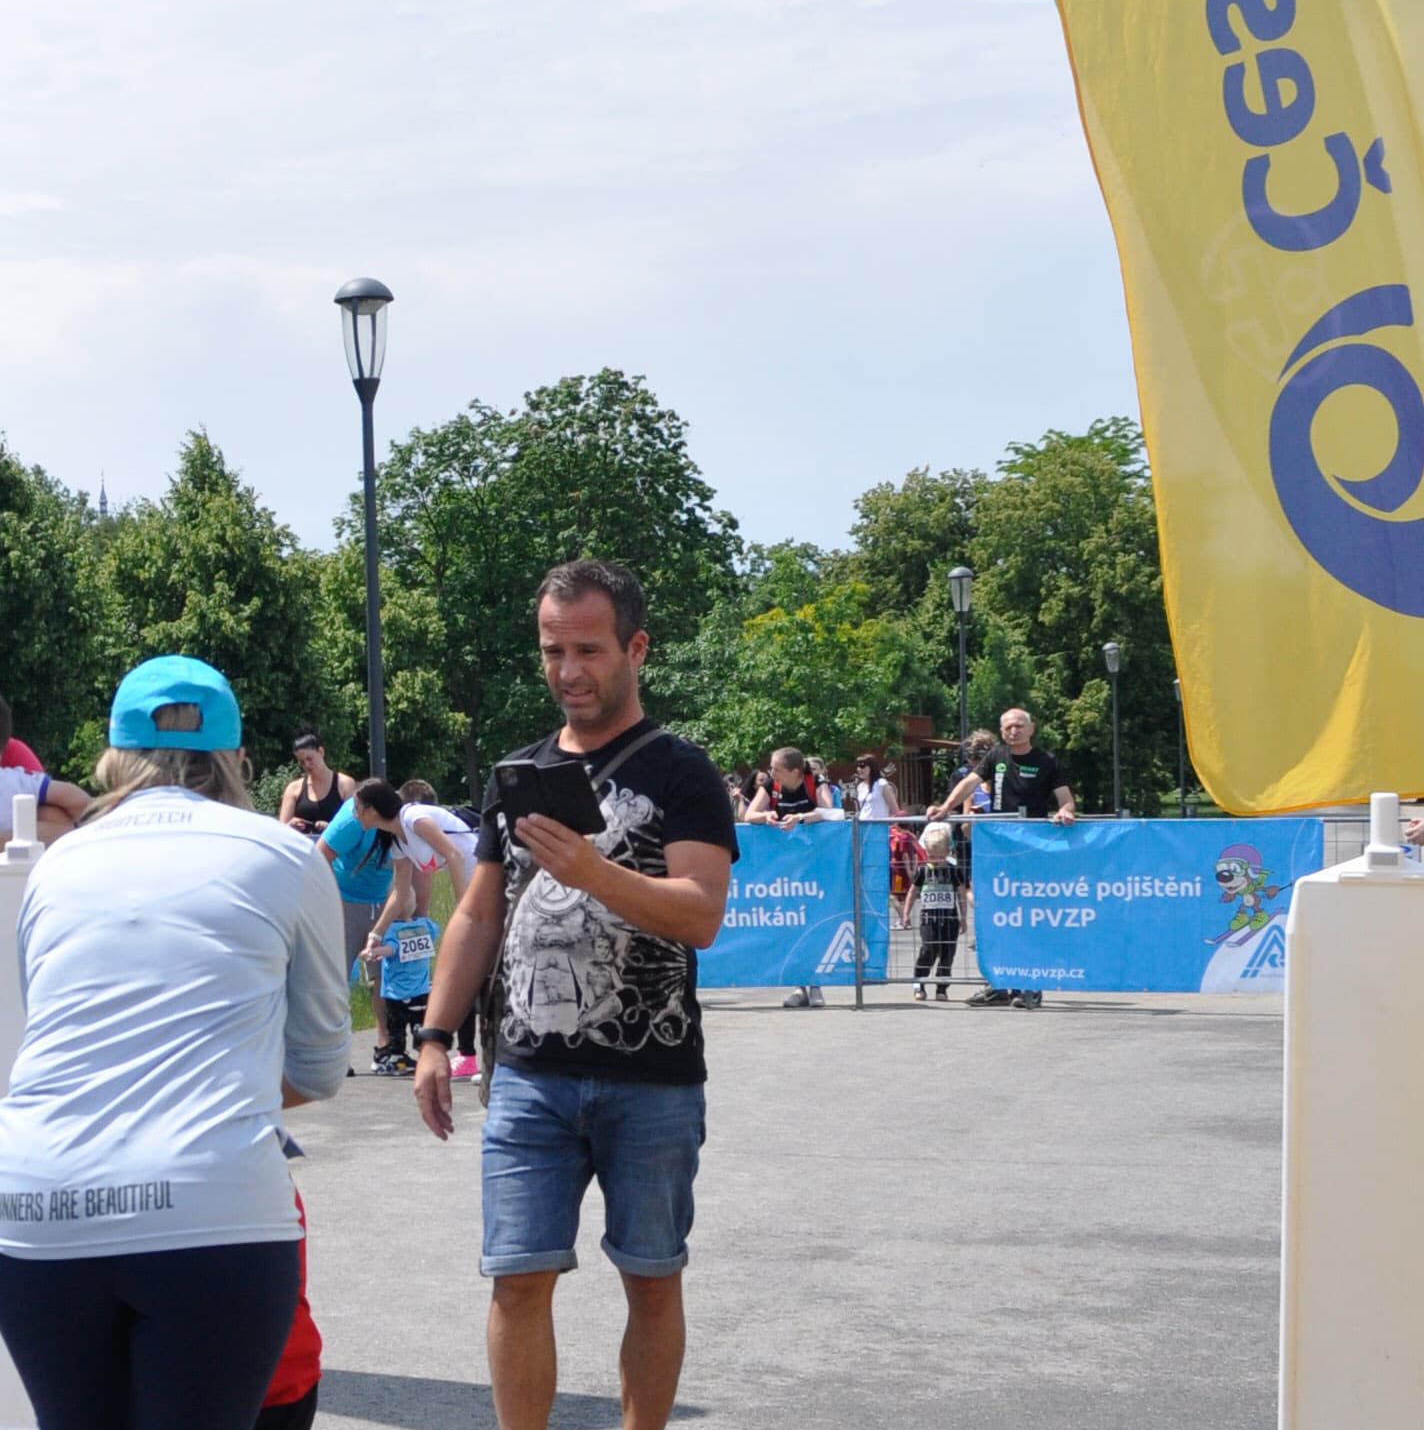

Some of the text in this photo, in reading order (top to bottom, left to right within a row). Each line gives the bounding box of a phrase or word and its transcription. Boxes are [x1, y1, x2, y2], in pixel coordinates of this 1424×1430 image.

[744, 877, 825, 900] rodinu,
[992, 872, 1203, 902] Úrazové pojištění
[723, 904, 807, 928] dnikání
[992, 907, 1097, 928] od PVZP
[401, 937, 431, 954] 2062
[992, 965, 1086, 980] www.pvzp.cz
[49, 1189, 80, 1220] ARE
[85, 1180, 174, 1218] BEAUTIFUL
